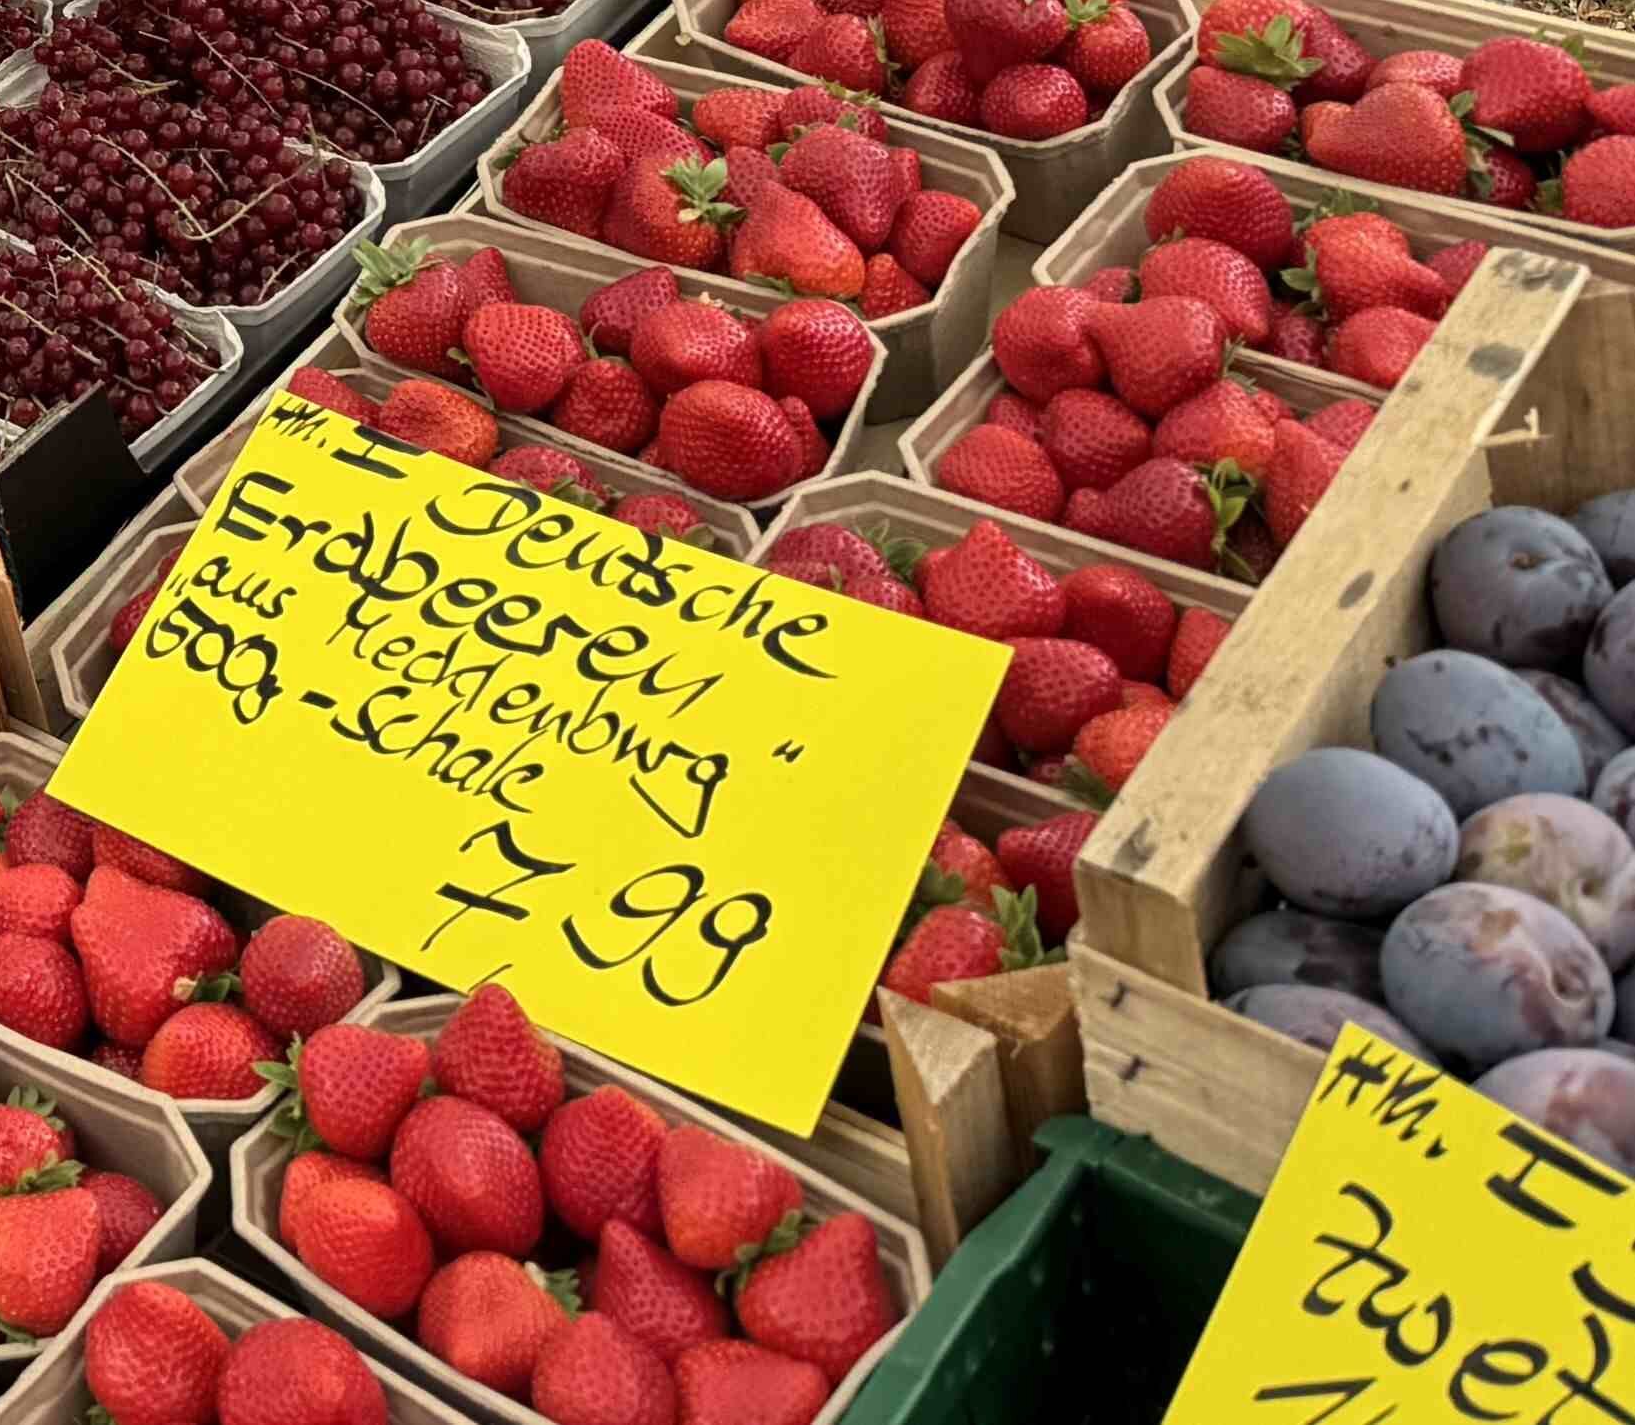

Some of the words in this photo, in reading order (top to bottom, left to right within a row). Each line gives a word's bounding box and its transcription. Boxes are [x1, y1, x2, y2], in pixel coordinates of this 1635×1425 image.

[329, 425, 431, 480] I
[423, 480, 840, 680] Deutsche
[146, 596, 283, 726] 500g
[1485, 1120, 1631, 1232] I
